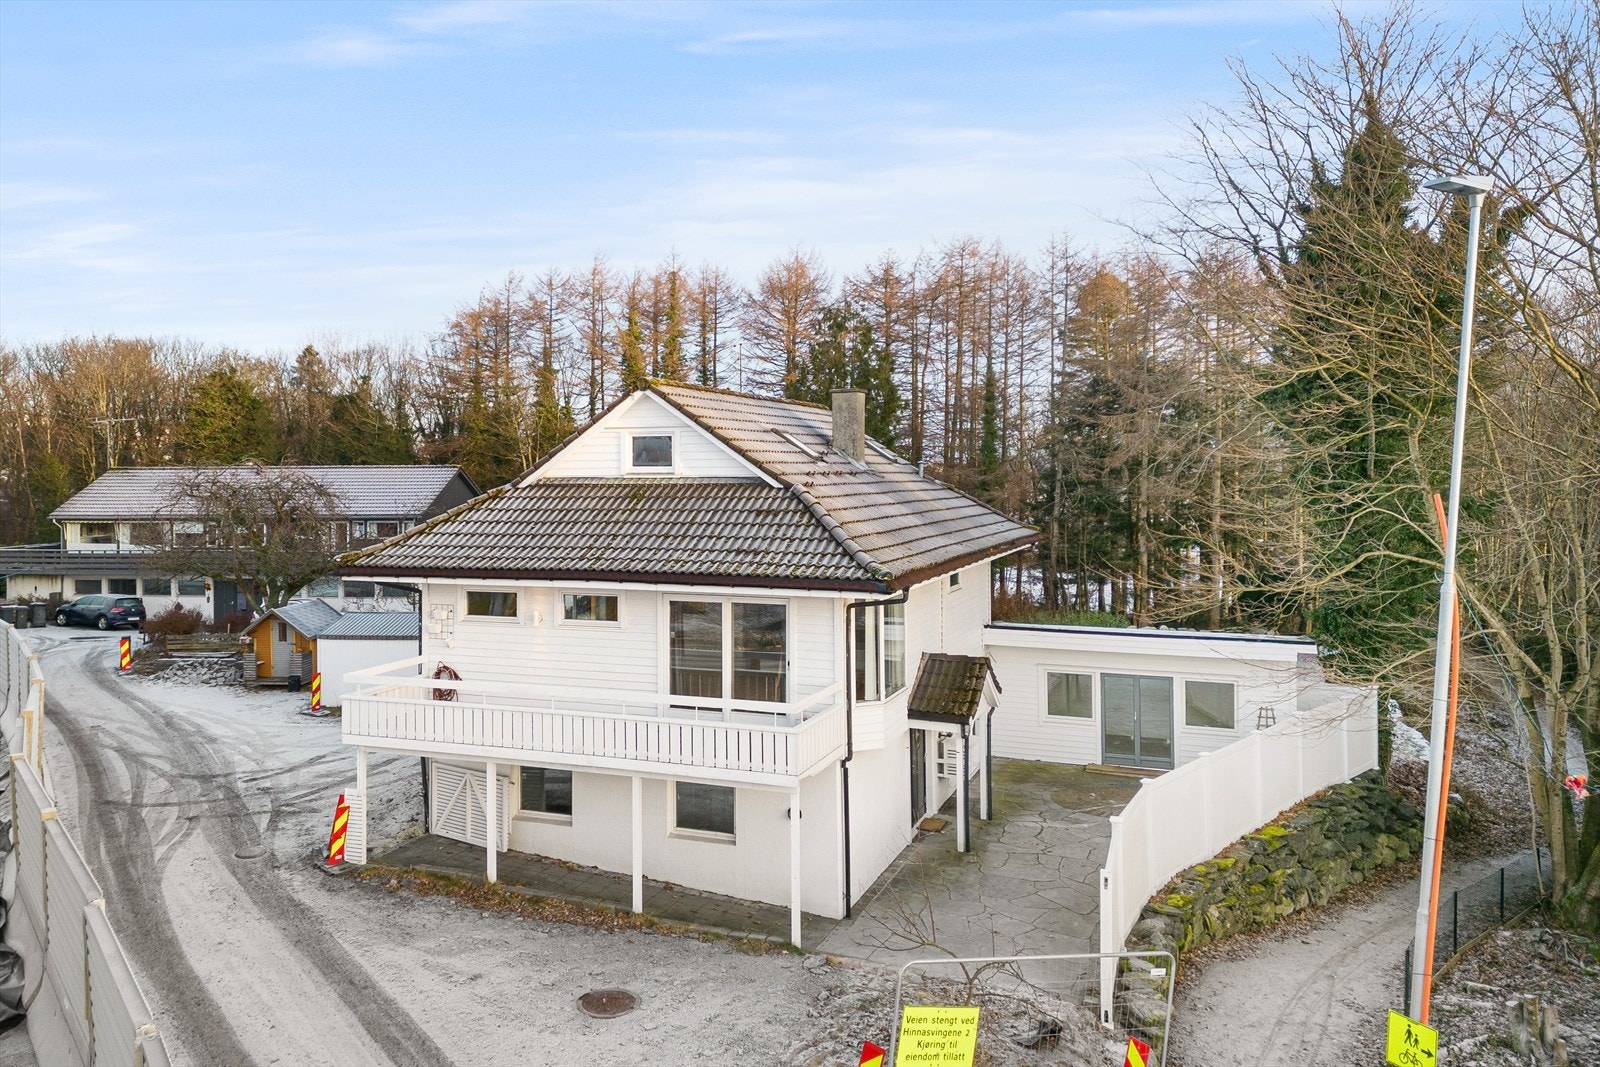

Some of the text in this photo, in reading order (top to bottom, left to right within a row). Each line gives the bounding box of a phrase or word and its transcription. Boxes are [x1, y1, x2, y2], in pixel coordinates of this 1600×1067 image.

[906, 1015, 975, 1027] Veien stengt ved
[903, 1028, 971, 1039] Hinnasvingene 2
[917, 1040, 958, 1051] Kjøring til
[905, 1052, 965, 1061] eiendom tillatt
